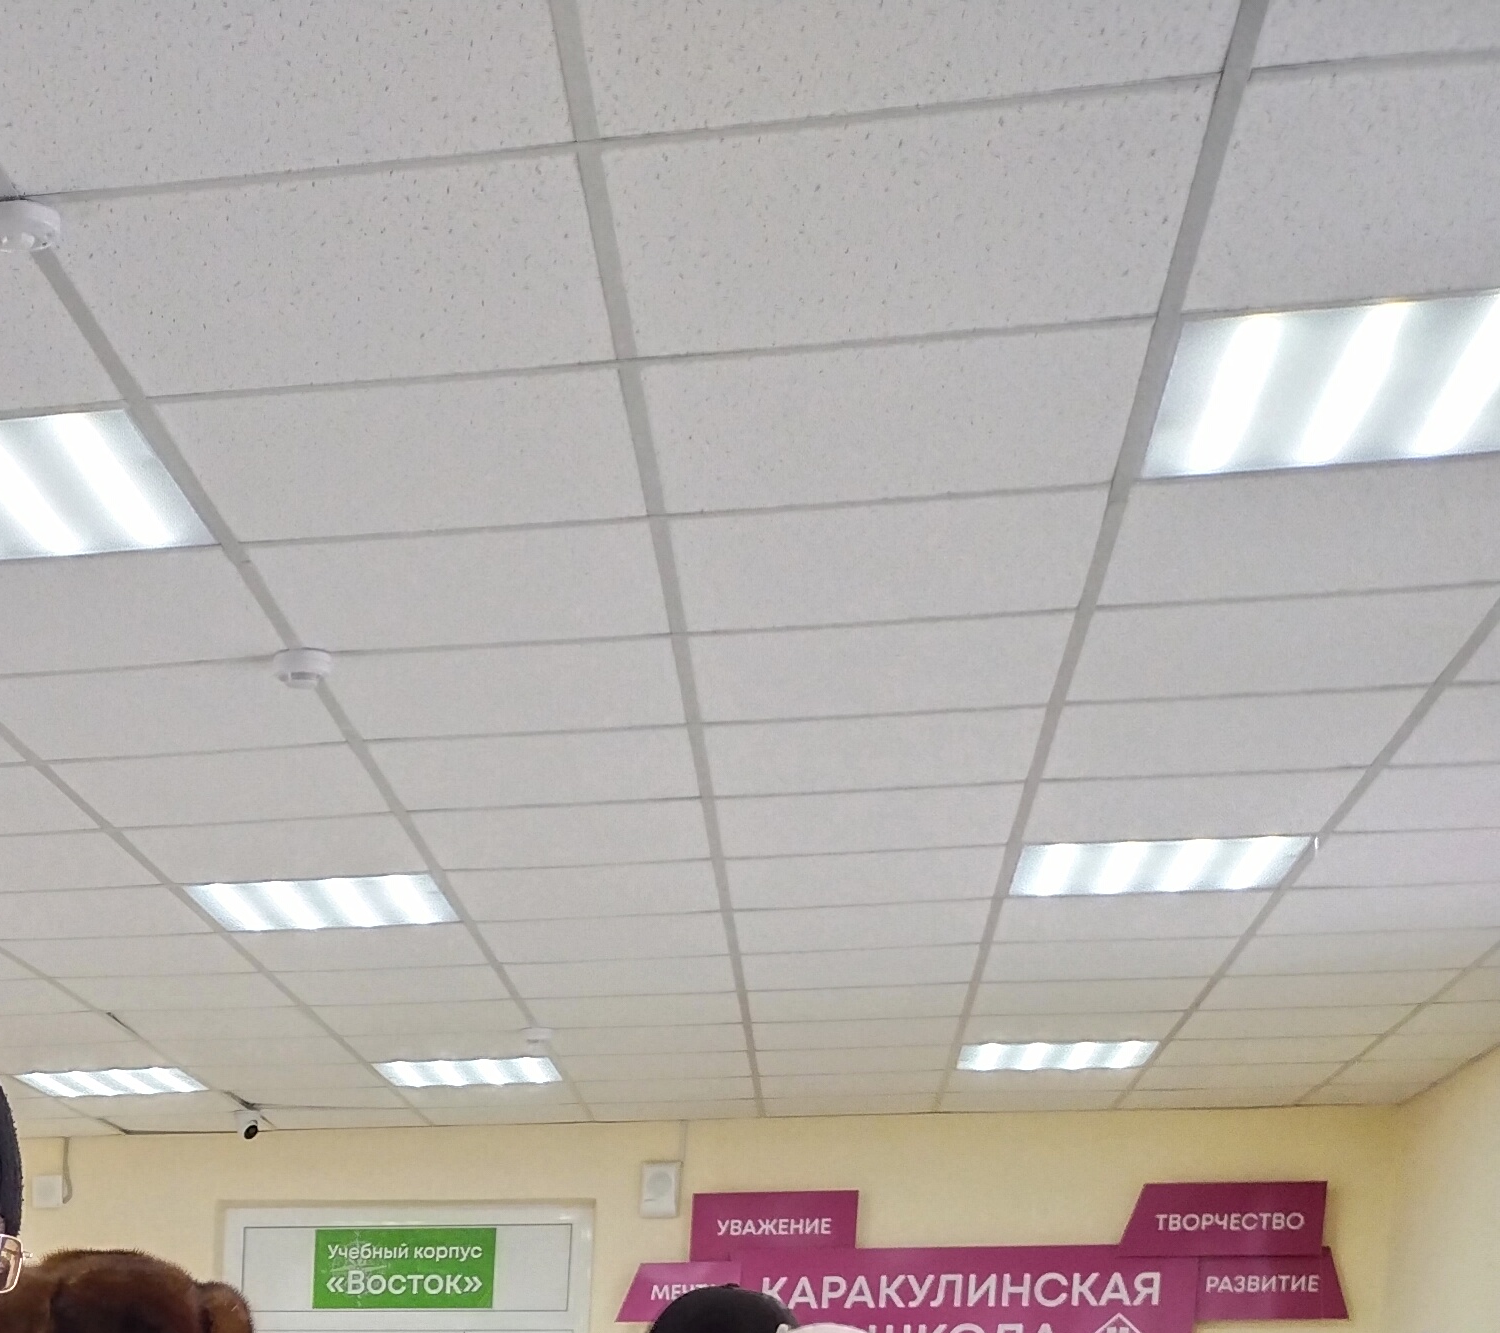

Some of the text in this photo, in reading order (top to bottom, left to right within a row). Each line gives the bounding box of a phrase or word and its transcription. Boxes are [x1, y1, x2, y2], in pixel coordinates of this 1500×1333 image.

[717, 1218, 832, 1237] УВАЖЕНИЕ
[1155, 1212, 1305, 1232] ТВОРЧЕСТВО
[328, 1243, 482, 1262] Учебный корпус
[760, 1271, 1162, 1310] КАРАКУЛИНСКАЯ
[1205, 1274, 1320, 1293] РАЗВИТИЕ
